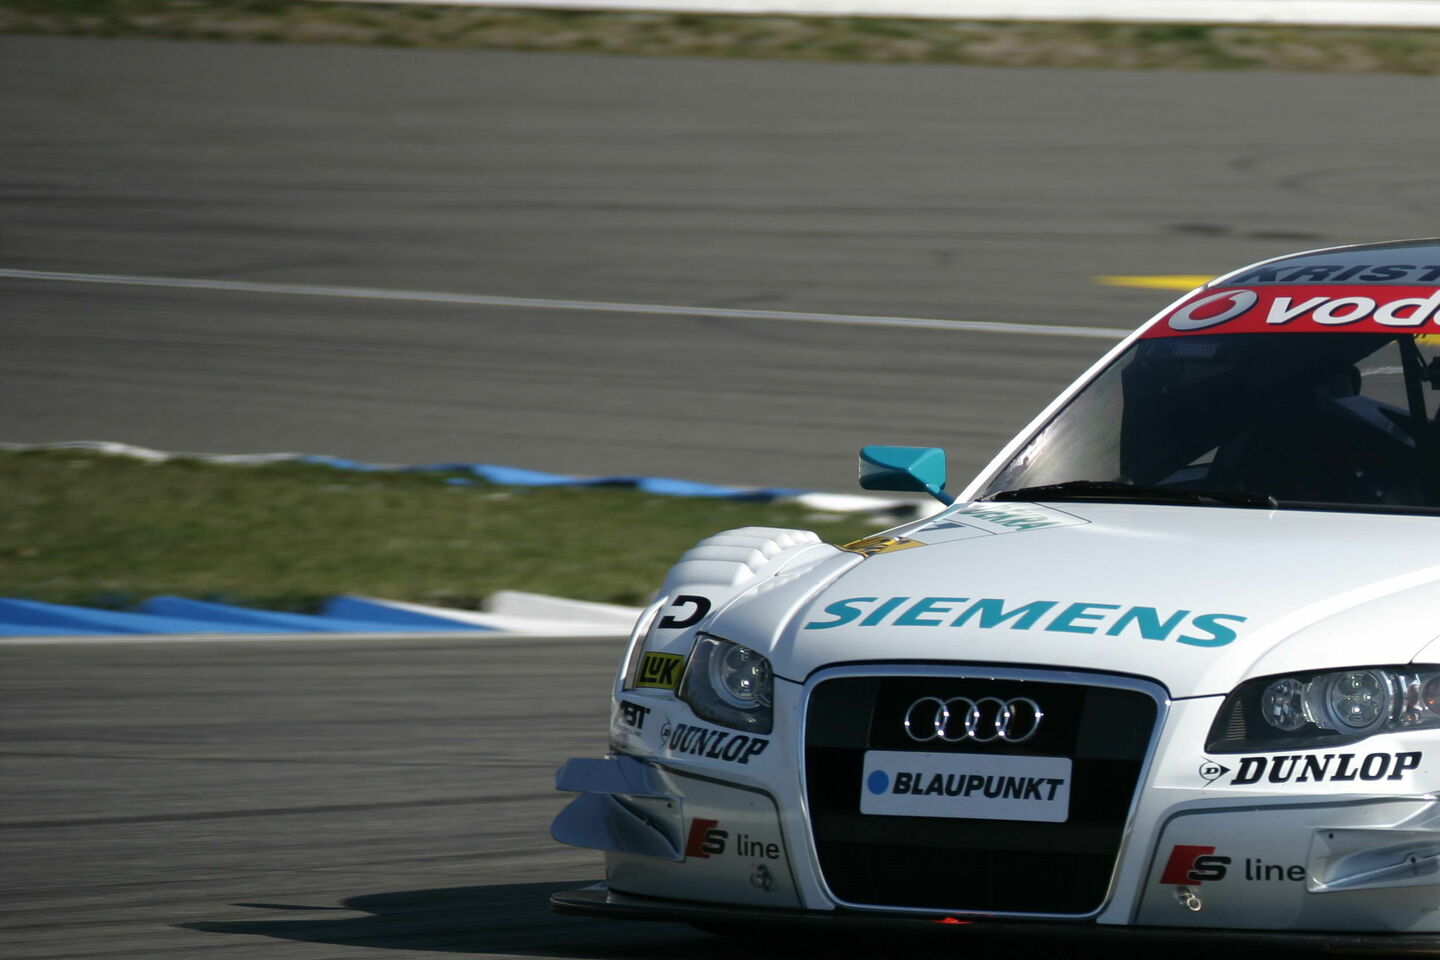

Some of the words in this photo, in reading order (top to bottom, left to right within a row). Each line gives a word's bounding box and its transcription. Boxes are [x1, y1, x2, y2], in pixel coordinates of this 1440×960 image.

[805, 596, 1248, 648] SIEMENS
[669, 723, 769, 765] DUNLOP
[1230, 751, 1423, 785] DUNLOP
[892, 771, 1064, 802] BLAUPUNKT
[702, 829, 728, 855] S
[737, 833, 780, 859] line
[1188, 855, 1232, 881] S
[1246, 858, 1307, 881] line
